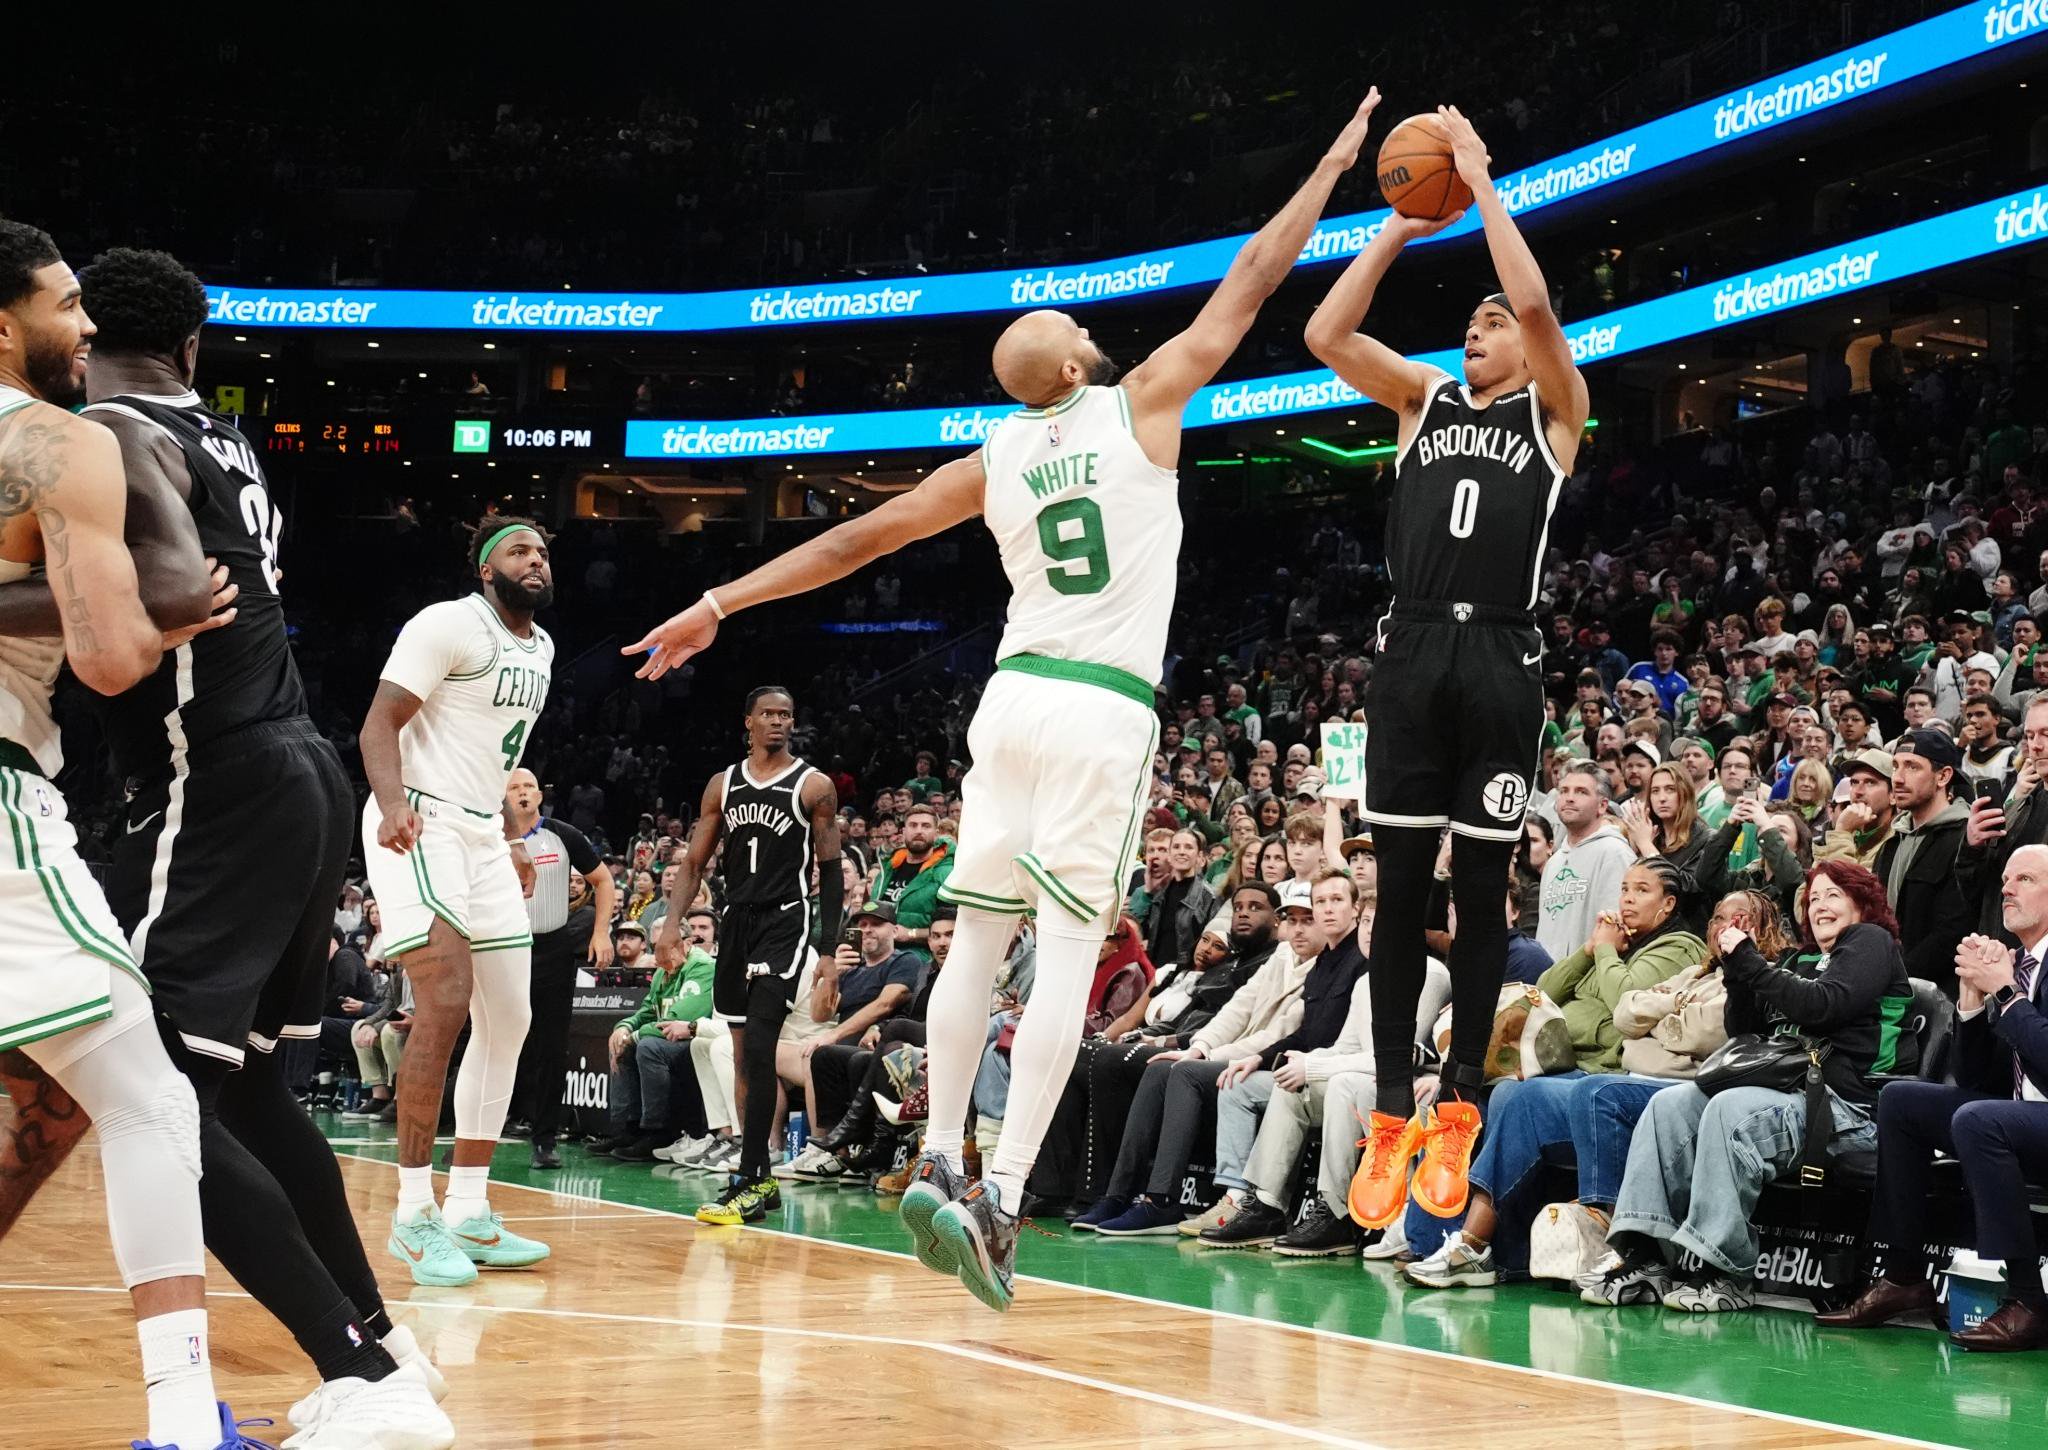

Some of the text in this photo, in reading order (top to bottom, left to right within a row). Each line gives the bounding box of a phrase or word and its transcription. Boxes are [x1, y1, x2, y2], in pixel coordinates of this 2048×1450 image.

[1714, 52, 1887, 138] ticketmaster
[1010, 261, 1174, 303] ticketmaster
[1713, 250, 1879, 321] ticketmaster
[207, 291, 376, 323] cketmaster
[473, 296, 663, 327] ticketmaster
[750, 286, 921, 322] ticketmaster
[274, 424, 300, 433] CELTICS
[374, 425, 391, 434] NETS
[457, 426, 487, 447] TD
[504, 429, 591, 447] 10:06 PM
[662, 425, 834, 454] ticketmaster
[1418, 424, 1534, 474] BROOKLYN
[1022, 453, 1098, 499] WHITE
[1449, 479, 1480, 539] 0
[1037, 497, 1111, 596] 9
[502, 719, 527, 771] 4
[1499, 780, 1515, 813] B
[725, 803, 794, 837] BROOKLYN
[747, 837, 758, 873] 1
[1754, 1246, 1835, 1289] etBlu
